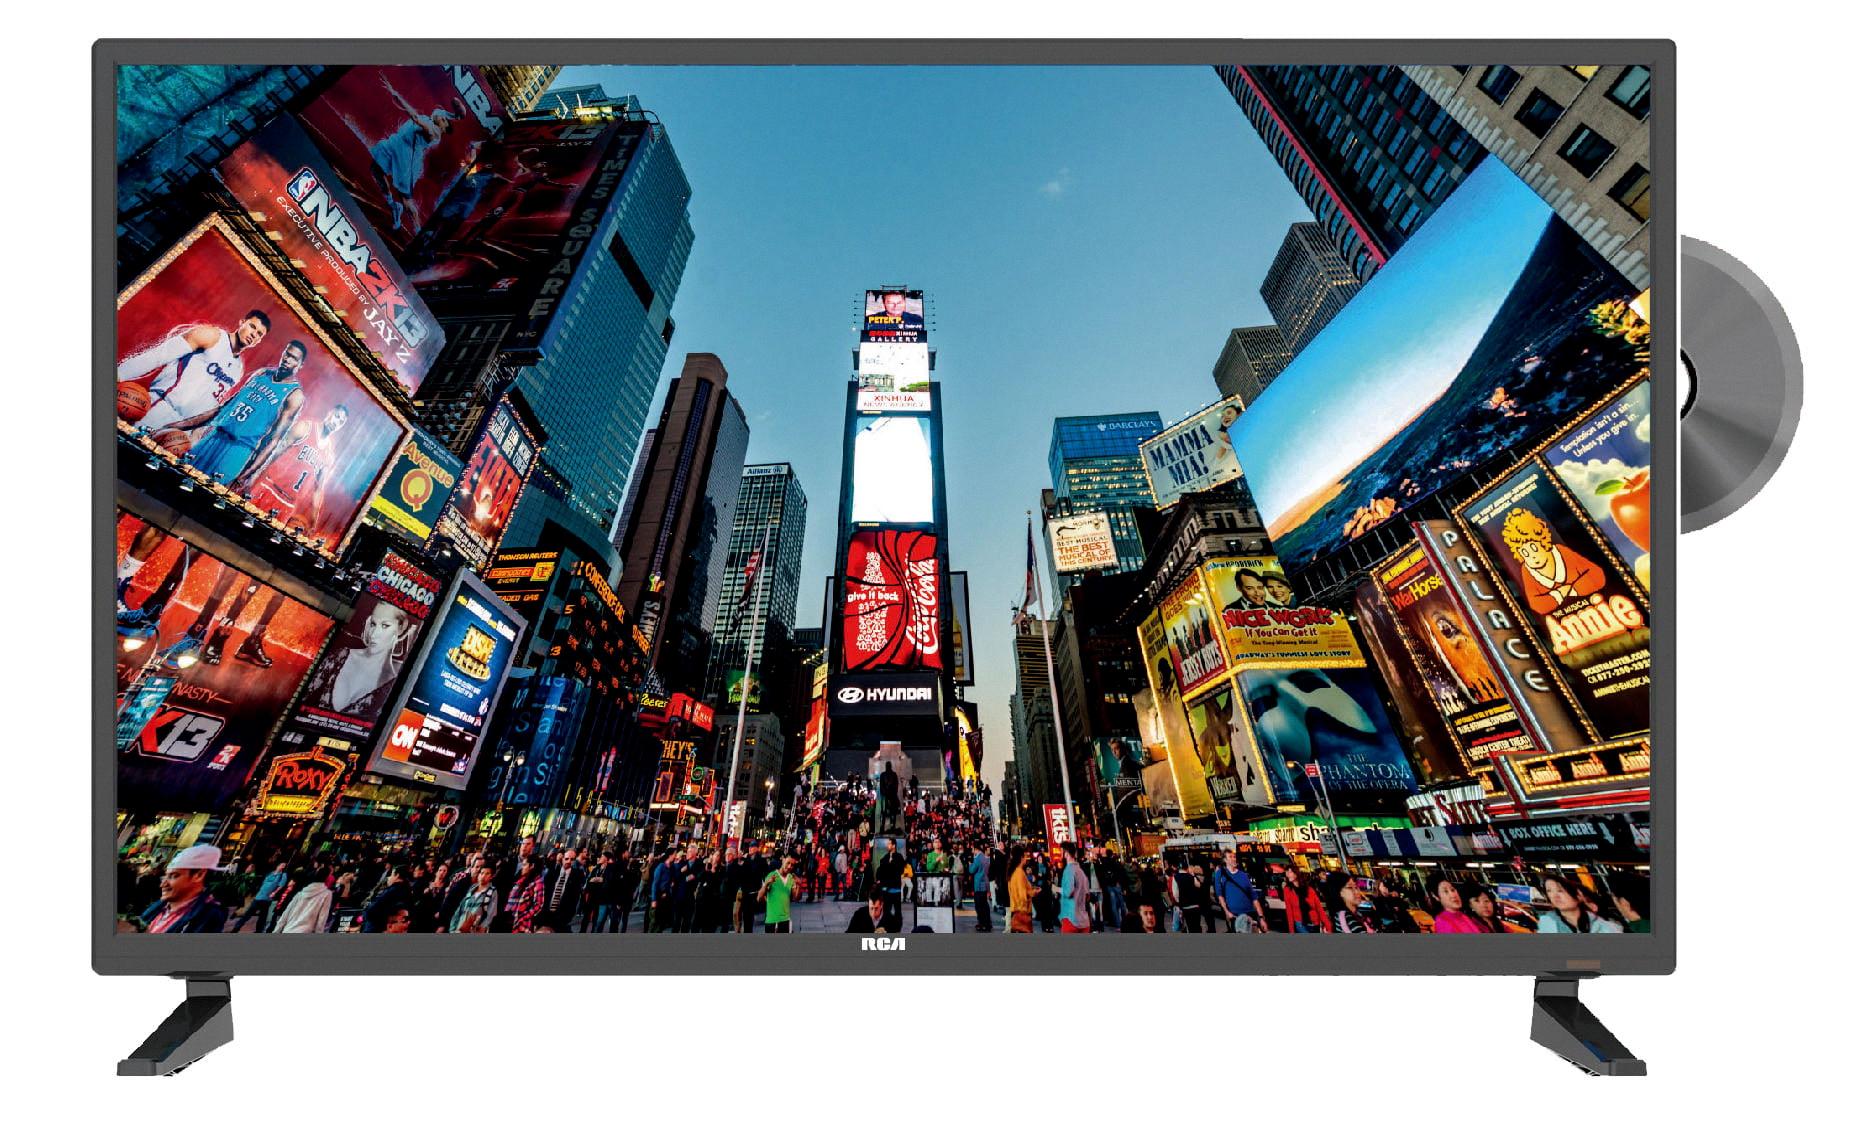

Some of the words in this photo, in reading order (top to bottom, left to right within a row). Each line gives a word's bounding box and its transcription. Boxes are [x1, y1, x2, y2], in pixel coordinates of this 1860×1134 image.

[592, 134, 638, 200] TIMES
[276, 196, 322, 251] EXECUTIVE
[320, 250, 360, 296] PRODUCED
[358, 294, 370, 306] BY
[528, 207, 598, 319] SQUARE
[363, 307, 399, 346] JAY
[395, 345, 411, 364] Z
[229, 402, 254, 422] 35
[1108, 419, 1160, 430] BARCLAYS
[1149, 424, 1214, 472] MAMMA
[1595, 431, 1611, 446] you
[401, 441, 455, 488] Avenue
[1168, 451, 1209, 488] MIA!
[293, 472, 308, 491] 1
[401, 469, 433, 513] Q
[1057, 546, 1080, 555] THE
[1081, 541, 1109, 552] BEST
[1058, 551, 1097, 561] MUSICAL
[1099, 548, 1111, 556] OF
[376, 565, 435, 606] CHICAGO
[847, 591, 867, 603] give
[868, 590, 876, 600] it
[877, 591, 899, 601] back
[1165, 602, 1184, 621] GOES
[1221, 608, 1271, 630] NICE
[1266, 606, 1335, 629] WORK
[1440, 529, 1550, 692] PALACE
[1245, 627, 1253, 638] If
[1255, 628, 1273, 638] You
[1273, 626, 1290, 637] Can
[1291, 628, 1308, 638] Get
[1545, 592, 1644, 656] Annie
[171, 681, 218, 703] NASTY
[867, 687, 932, 702] HYUNDAI
[1321, 763, 1411, 780] PHANTOM
[1571, 757, 1608, 779] Annie
[1050, 807, 1070, 845] tkts
[1509, 826, 1533, 841] BOX
[1530, 823, 1569, 838] OFFICE
[1565, 821, 1599, 837] HERE
[861, 937, 906, 951] RCA
